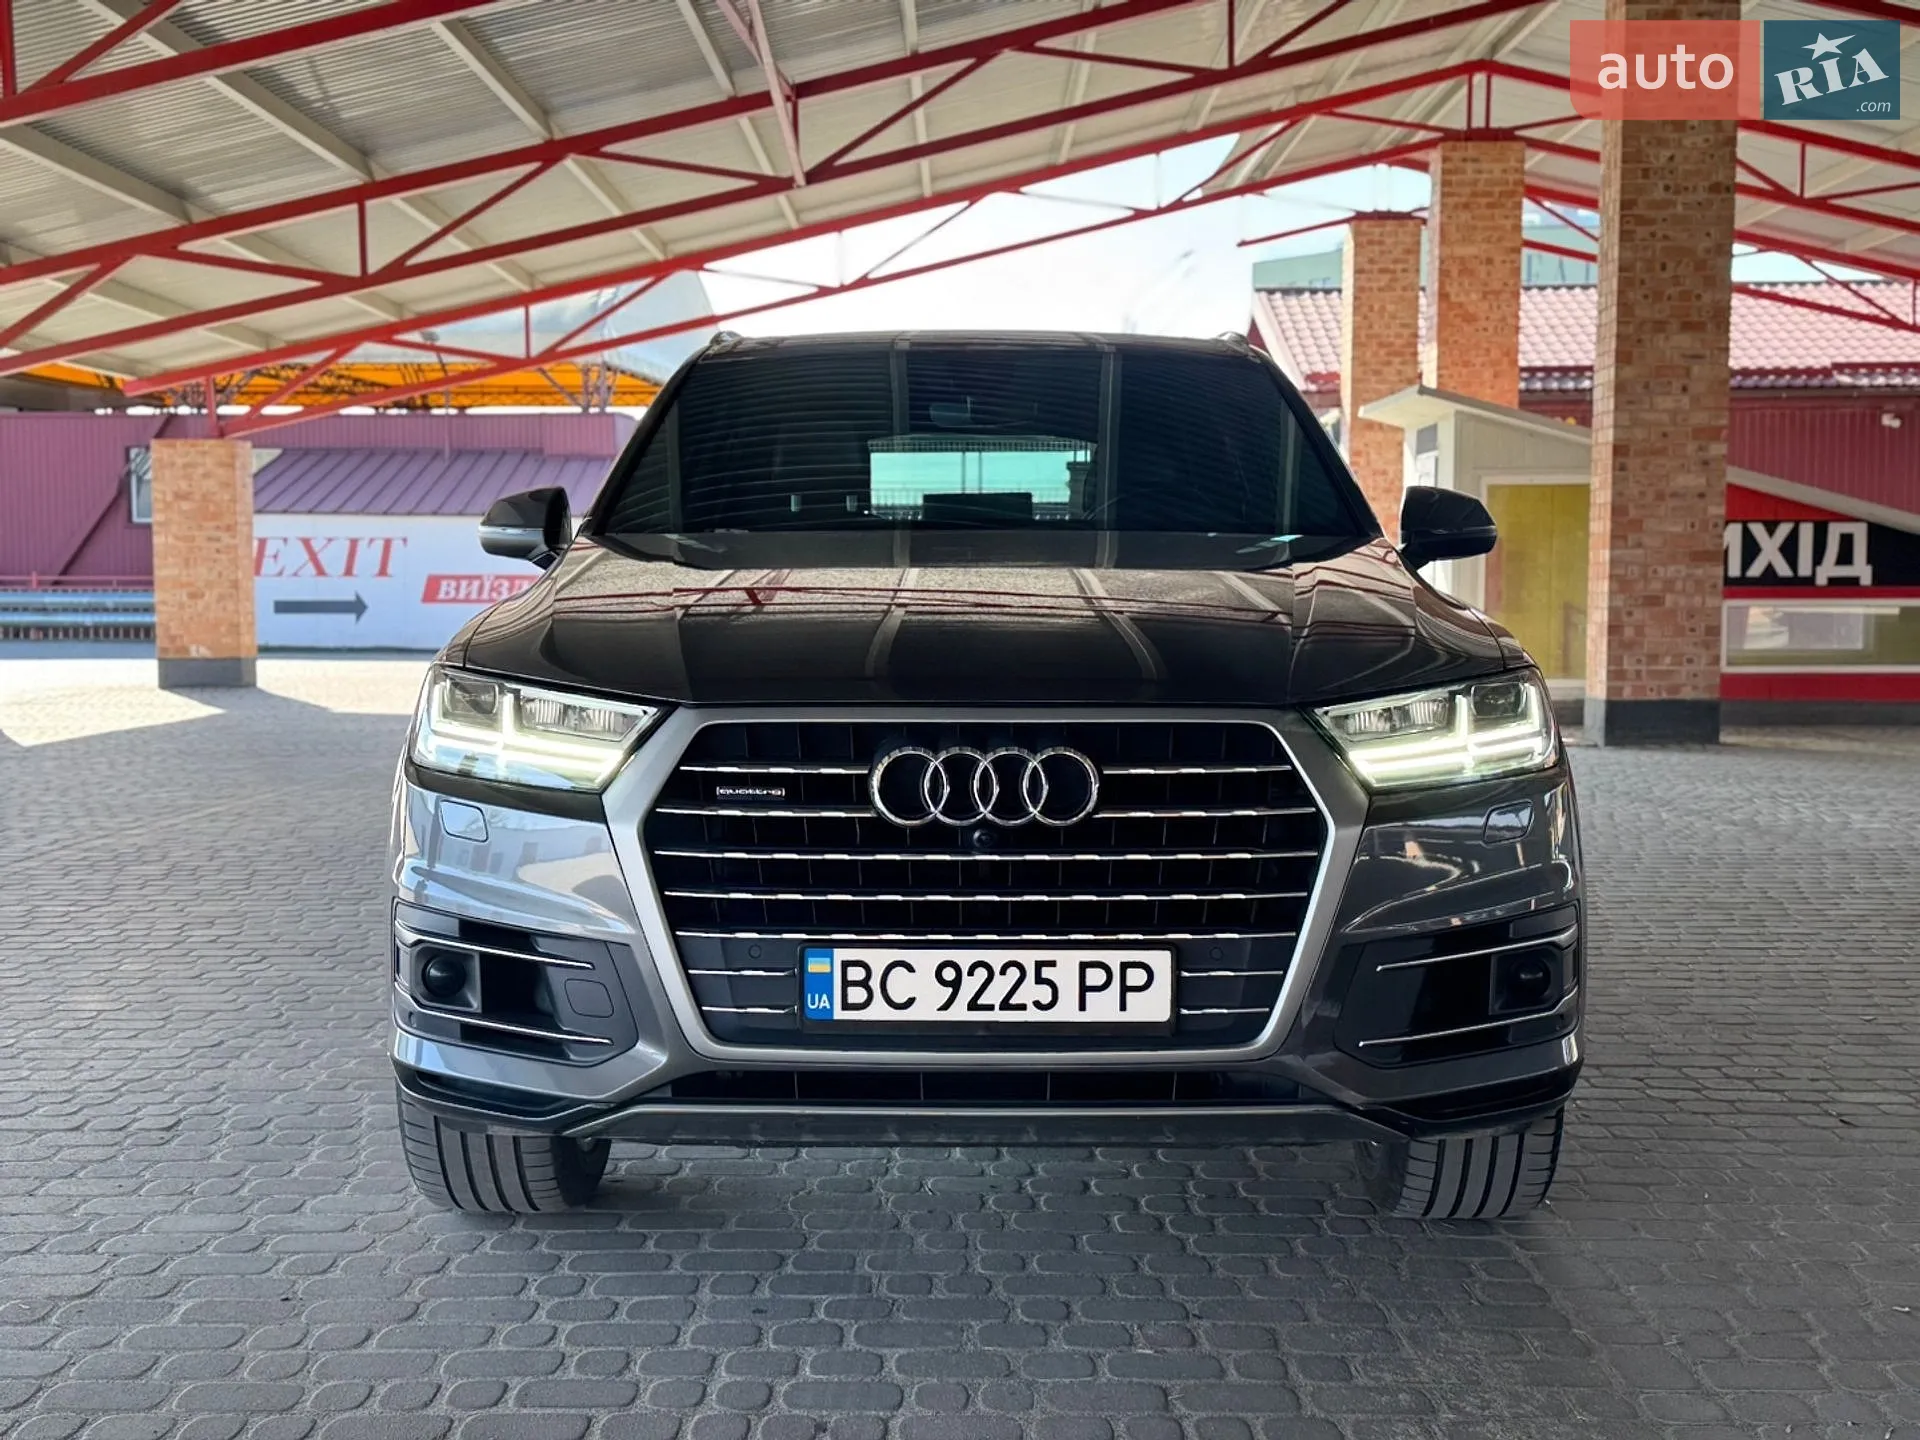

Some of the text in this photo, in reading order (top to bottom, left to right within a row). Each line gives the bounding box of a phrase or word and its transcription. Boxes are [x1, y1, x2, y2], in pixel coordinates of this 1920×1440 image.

[254, 536, 408, 578] EXIT
[807, 993, 831, 1010] UA
[840, 959, 1155, 1012] BC 9225 PP
